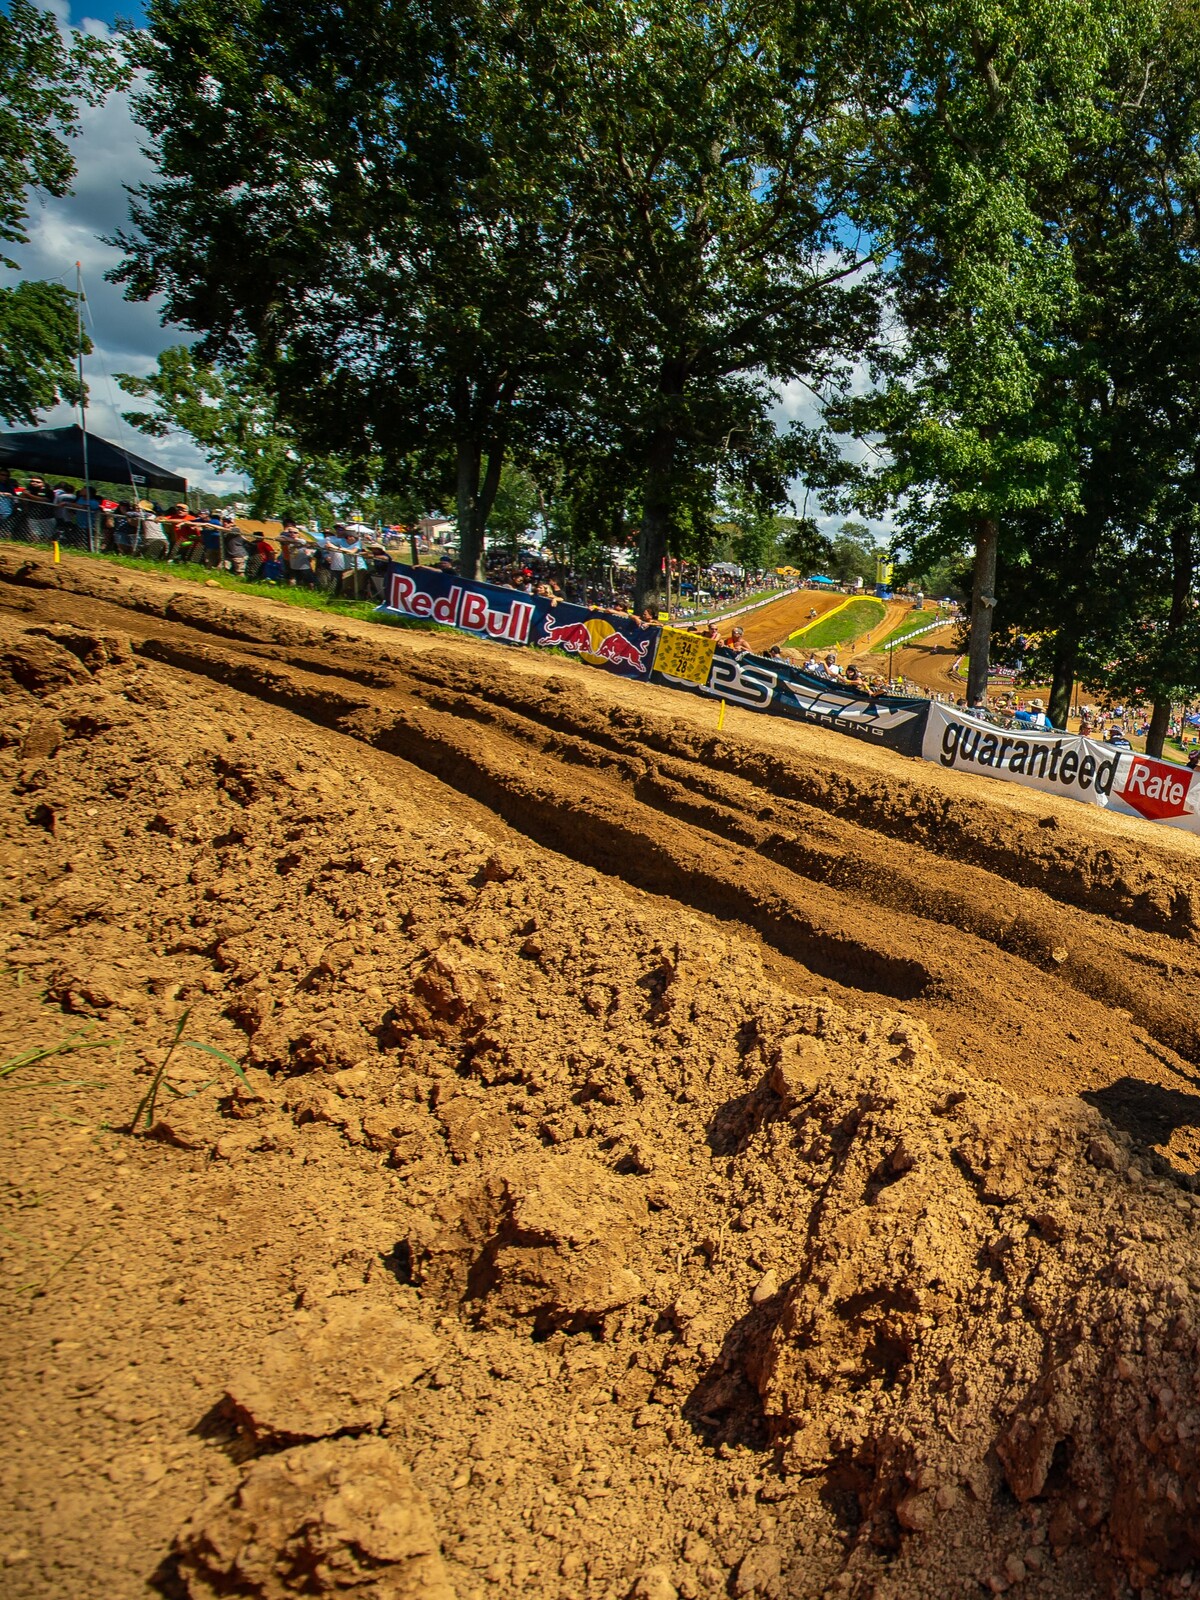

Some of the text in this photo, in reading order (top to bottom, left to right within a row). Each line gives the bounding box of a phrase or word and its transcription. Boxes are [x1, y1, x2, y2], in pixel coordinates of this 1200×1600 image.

[391, 573, 536, 644] Red Bull
[675, 659, 688, 673] 28
[680, 641, 692, 656] 34
[661, 654, 778, 709] PS
[805, 710, 884, 737] RACING
[940, 721, 1122, 796] guaranteed
[1127, 763, 1185, 806] Rate
